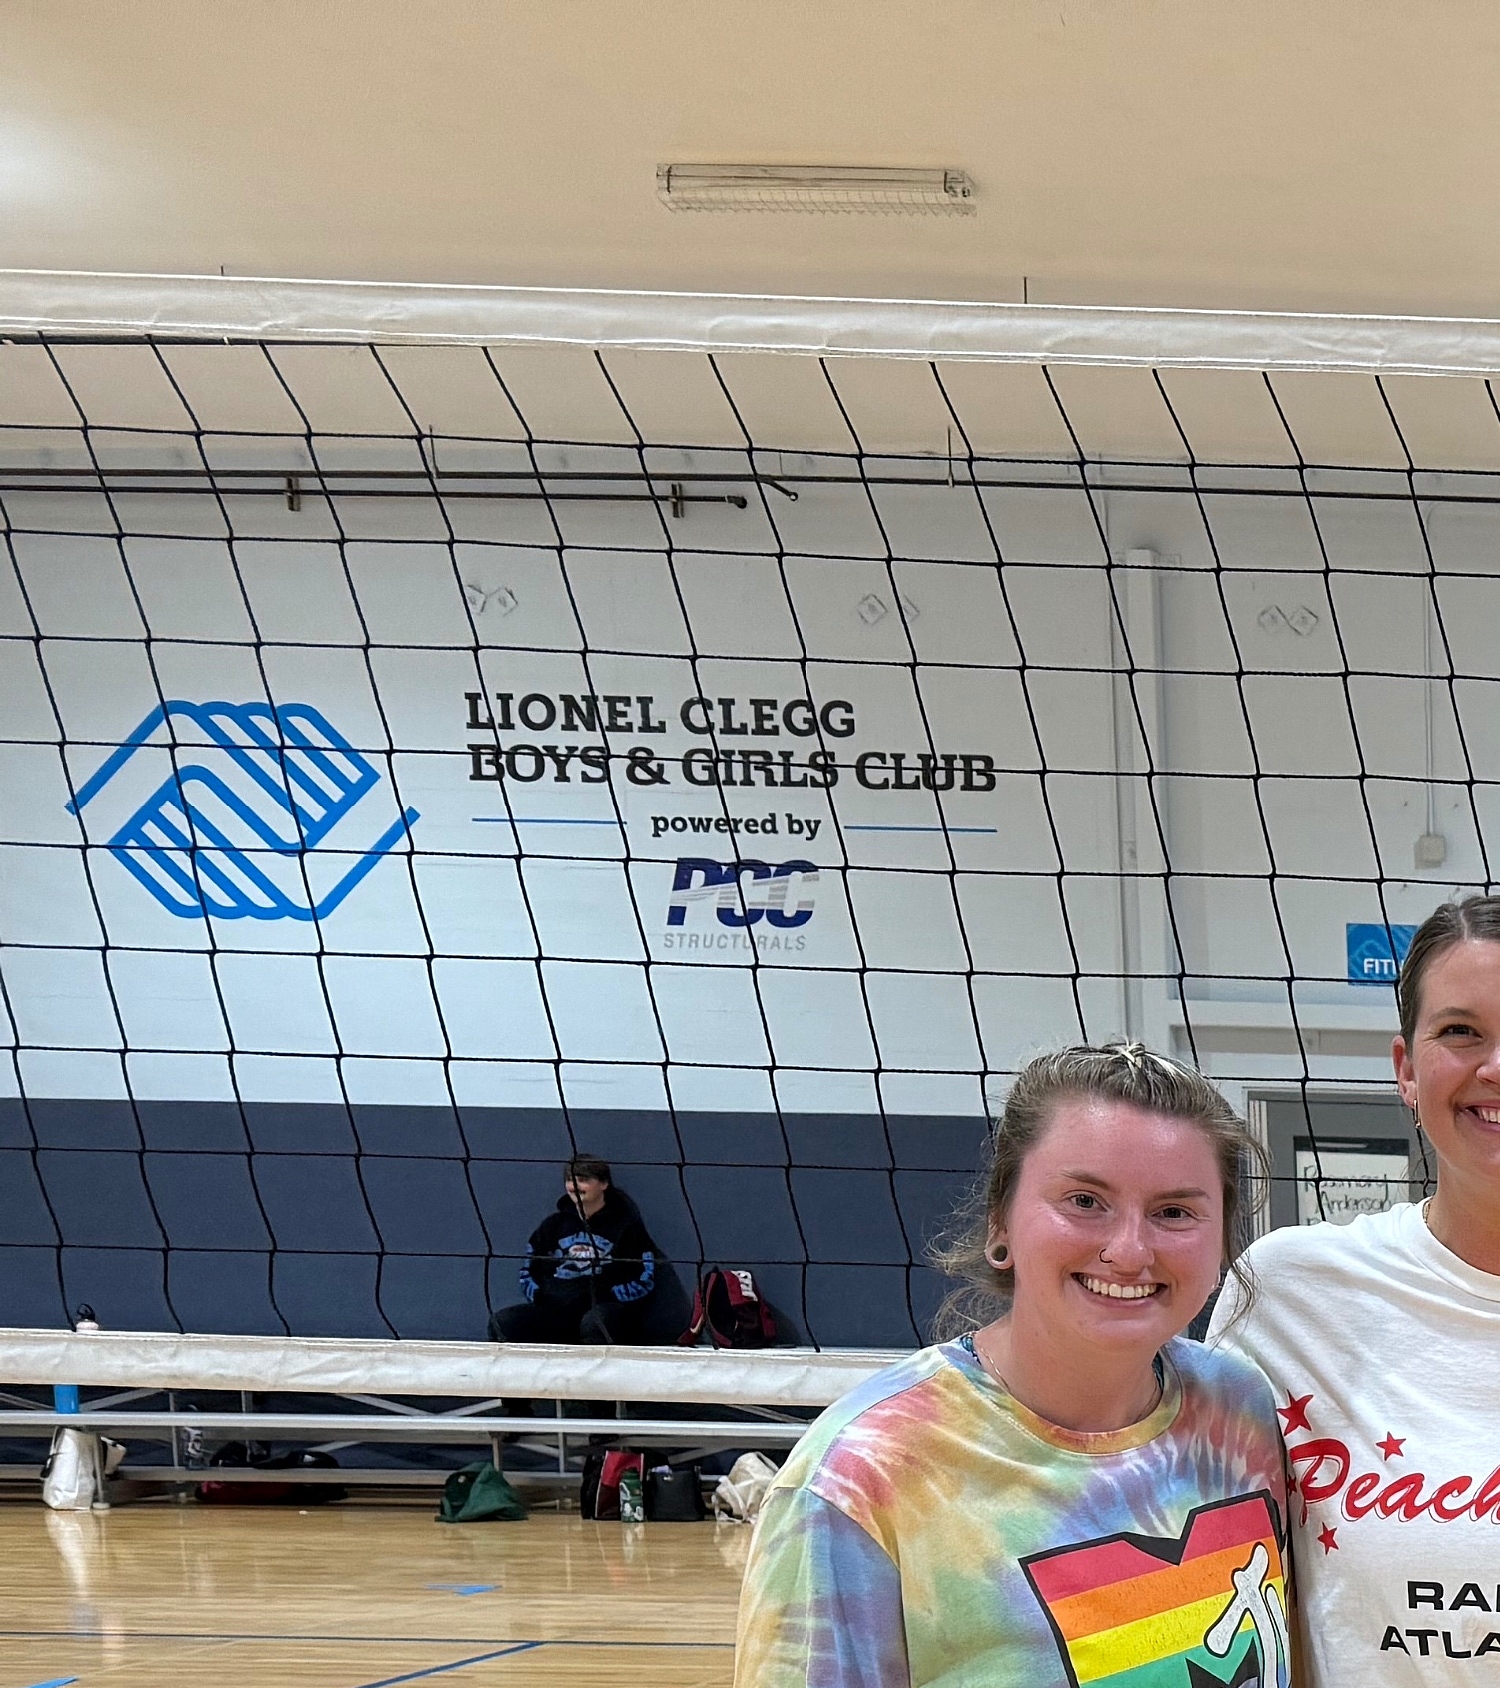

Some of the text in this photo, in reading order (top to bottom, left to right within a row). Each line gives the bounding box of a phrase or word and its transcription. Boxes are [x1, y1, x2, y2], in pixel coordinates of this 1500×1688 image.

[464, 692, 856, 738] LIONEL CLEGG
[468, 744, 997, 792] BOYS & GIRLS CLUB
[651, 813, 822, 841] powered by
[667, 857, 820, 928] PCC
[663, 932, 807, 950] STRUCTURALS
